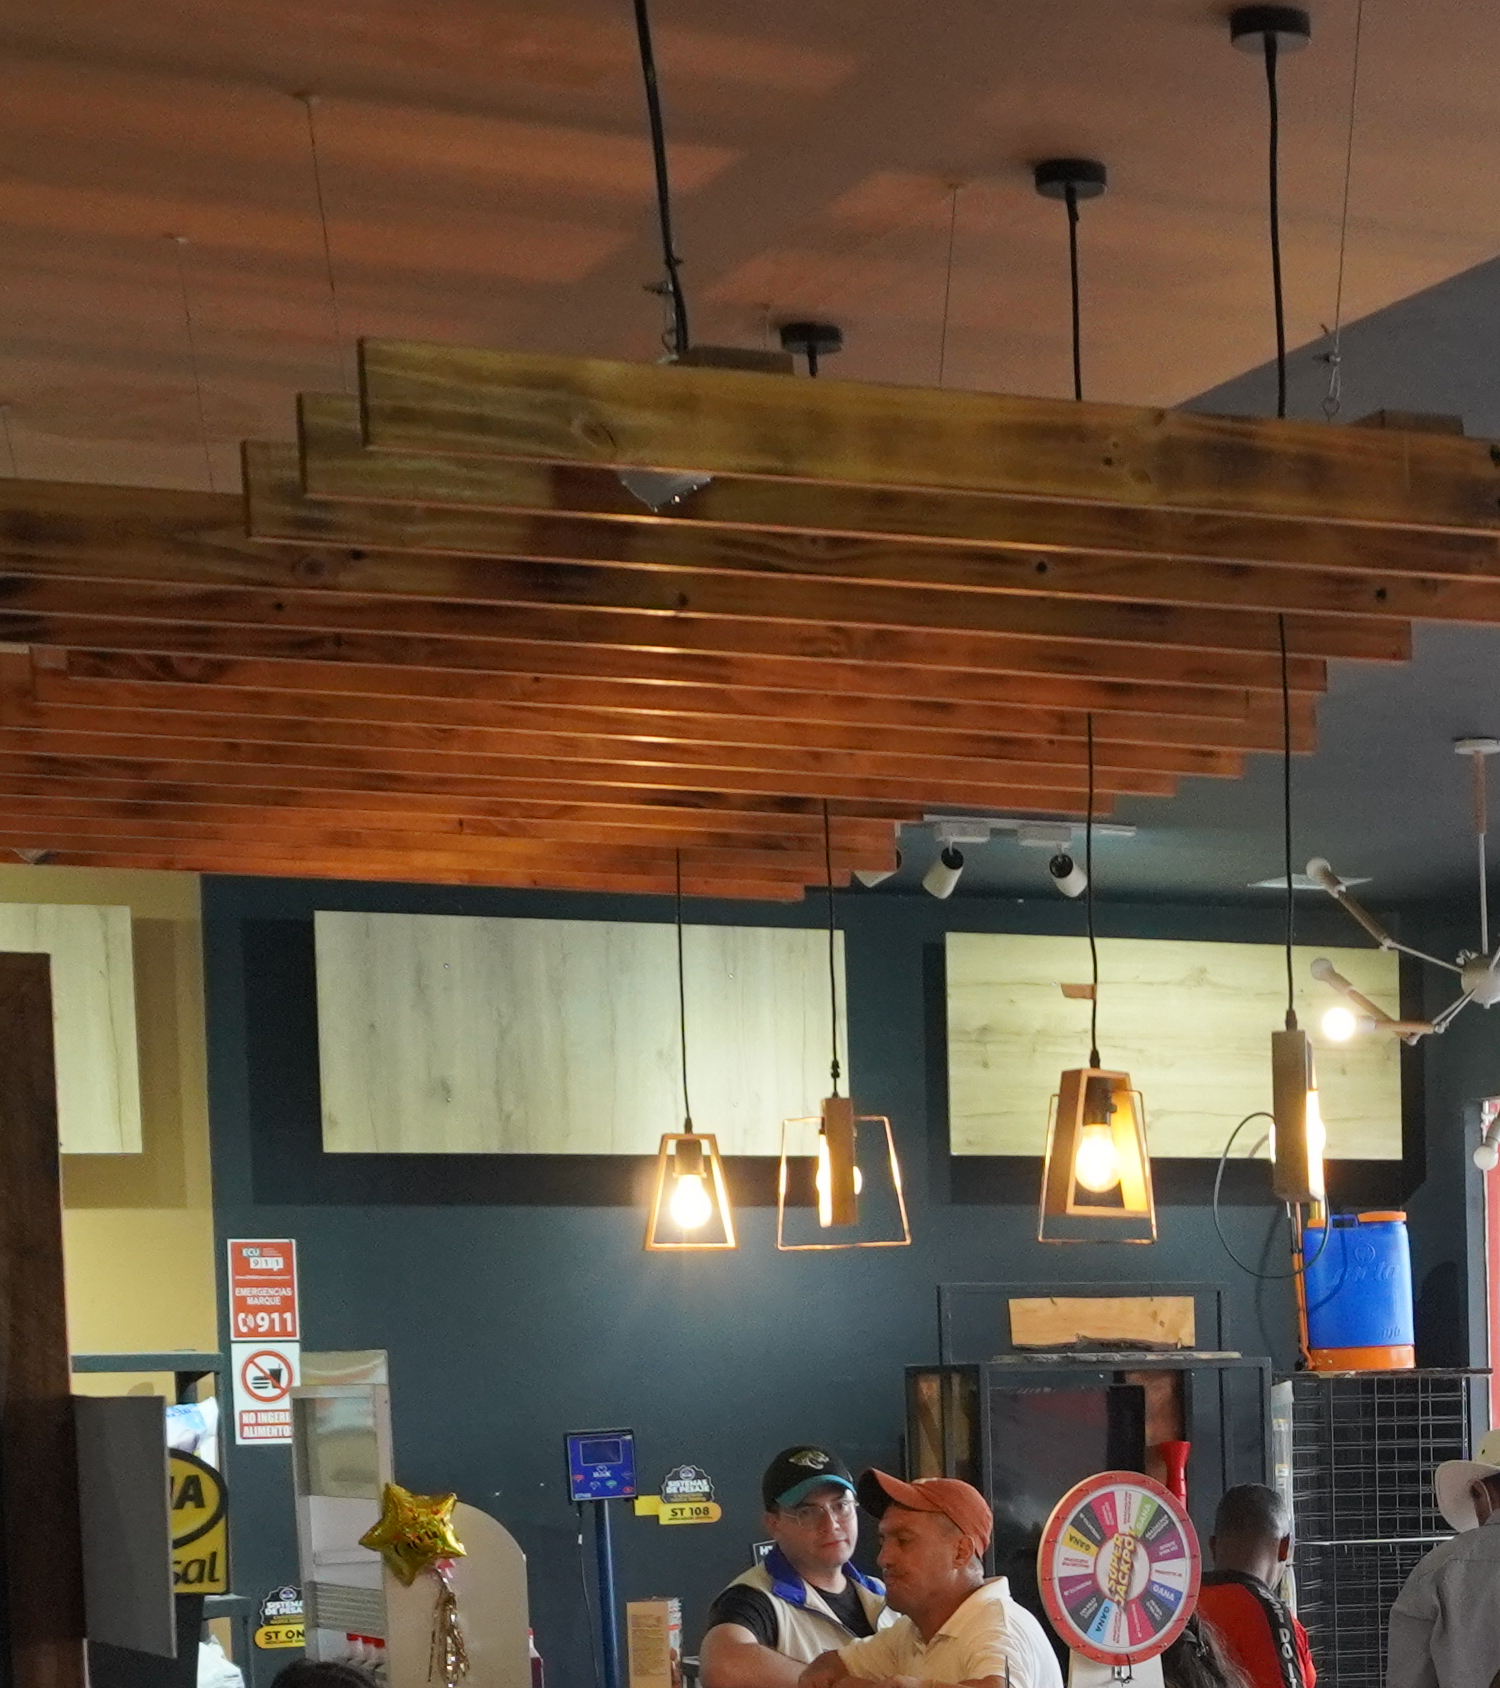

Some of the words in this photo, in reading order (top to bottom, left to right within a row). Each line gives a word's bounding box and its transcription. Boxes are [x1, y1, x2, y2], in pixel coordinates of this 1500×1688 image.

[235, 1287, 292, 1297] EMERGENCIAS
[246, 1296, 282, 1306] MARQUE
[255, 1311, 294, 1333] 911
[241, 1412, 257, 1424] NO
[242, 1424, 293, 1438] ALIMENTO
[670, 1507, 686, 1517] ST
[688, 1506, 711, 1517] 108
[1068, 1535, 1091, 1552] GANA
[1106, 1533, 1125, 1594] SUPER
[1152, 1584, 1175, 1602] GANA
[1094, 1605, 1110, 1633] GANA
[264, 1630, 281, 1641] ST
